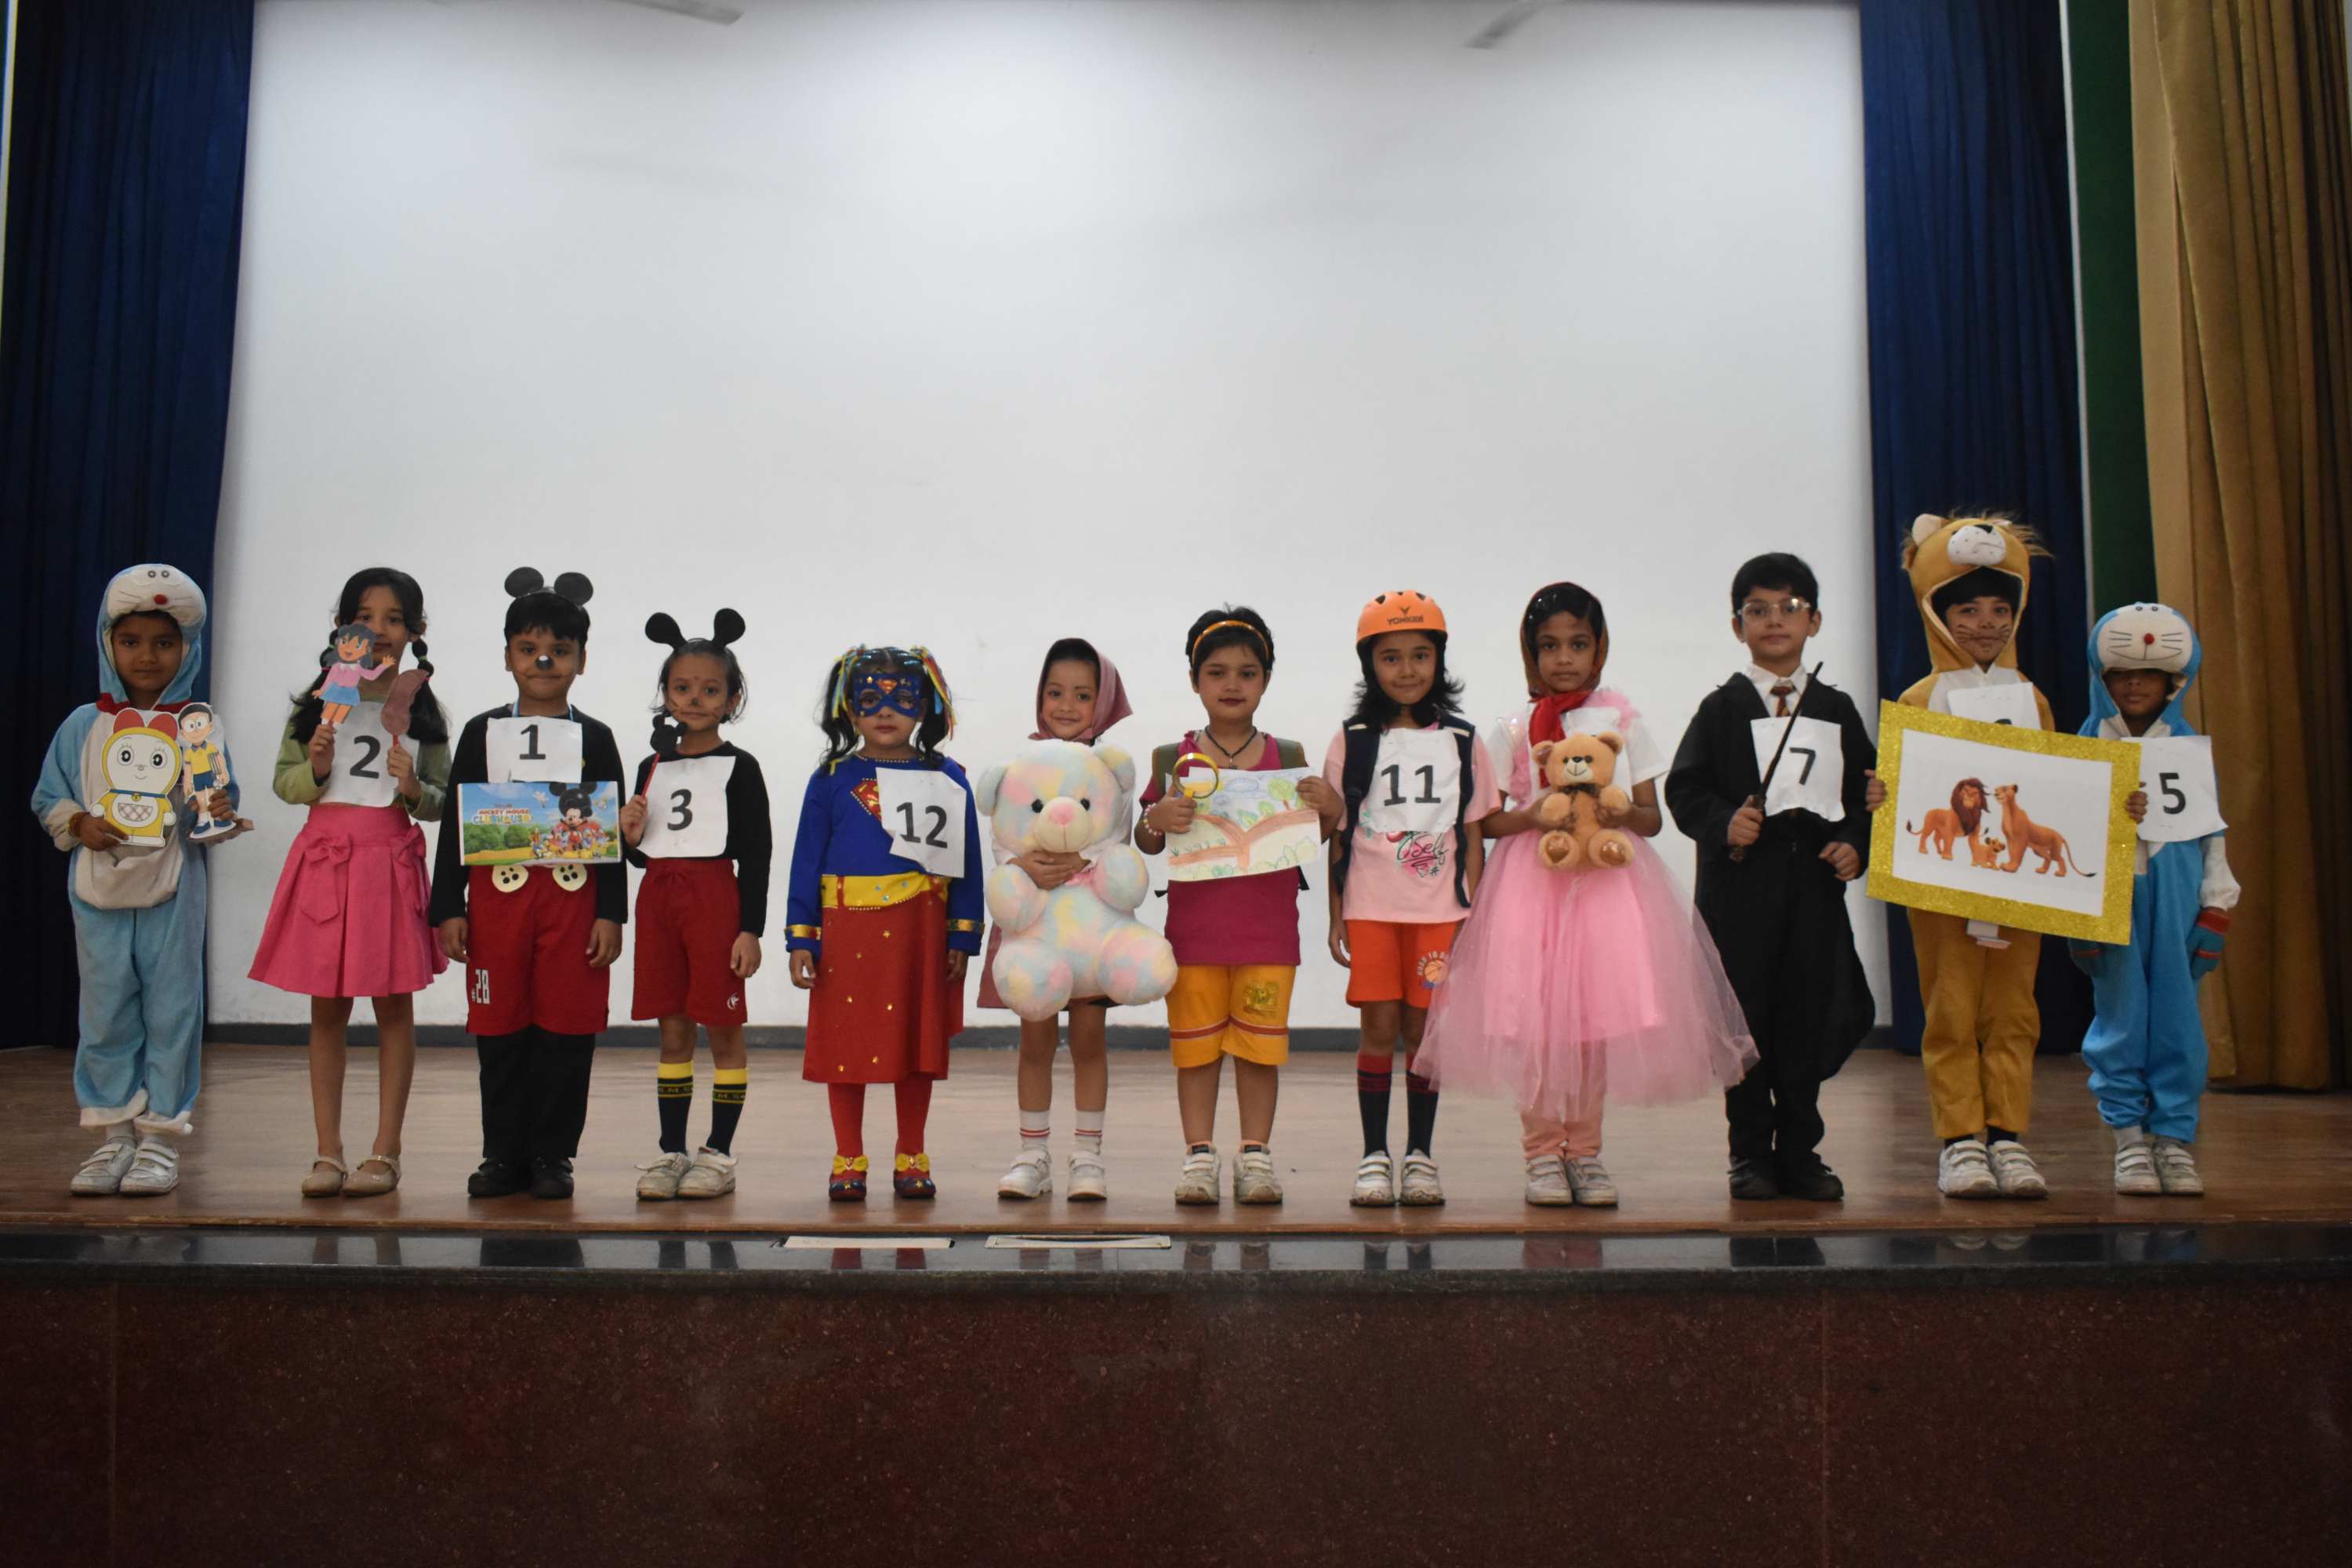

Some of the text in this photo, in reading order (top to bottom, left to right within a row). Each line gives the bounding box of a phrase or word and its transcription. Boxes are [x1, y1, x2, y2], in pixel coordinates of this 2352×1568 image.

[349, 735, 381, 779] 2
[519, 724, 546, 760] 1
[1381, 764, 1441, 807] 11
[1789, 747, 1817, 786] 7
[667, 789, 693, 831] 3
[2158, 772, 2187, 815] 5
[896, 802, 948, 849] 12
